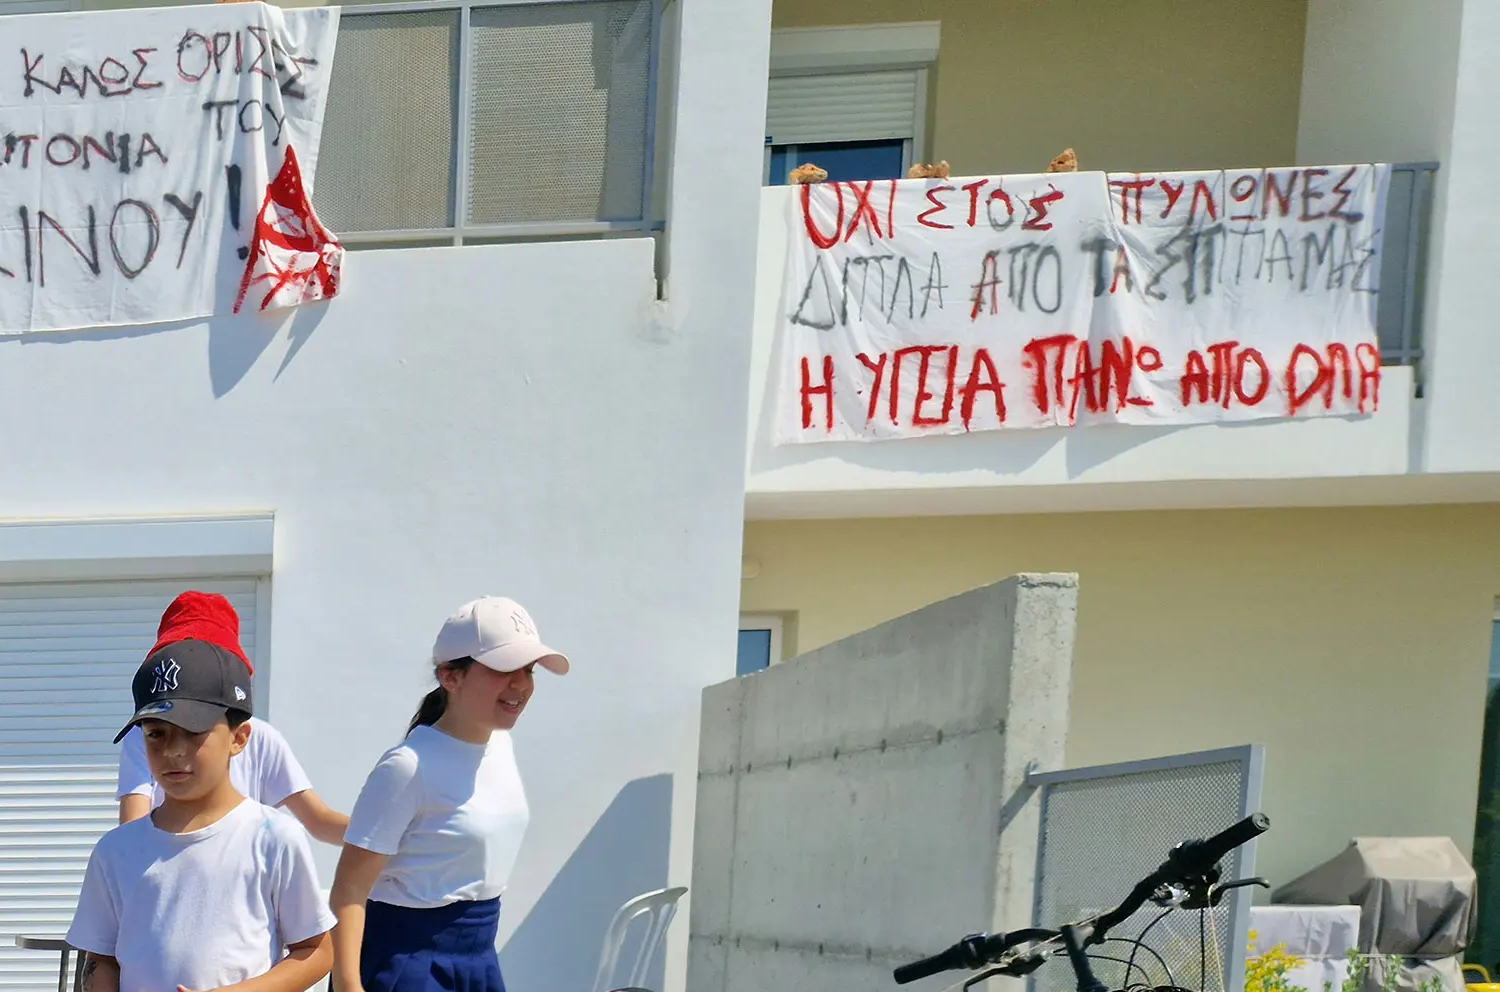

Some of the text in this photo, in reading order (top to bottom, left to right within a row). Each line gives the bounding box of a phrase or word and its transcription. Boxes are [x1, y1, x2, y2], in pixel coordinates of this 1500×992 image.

[202, 99, 286, 147] ΤΟΥ
[801, 179, 896, 249] ΟΧΙ
[789, 251, 948, 329] ΔΙΠΛΑ
[970, 243, 1062, 322] ΑΠΟ
[801, 354, 834, 430] Η
[1181, 340, 1270, 408] ΑΠΟ
